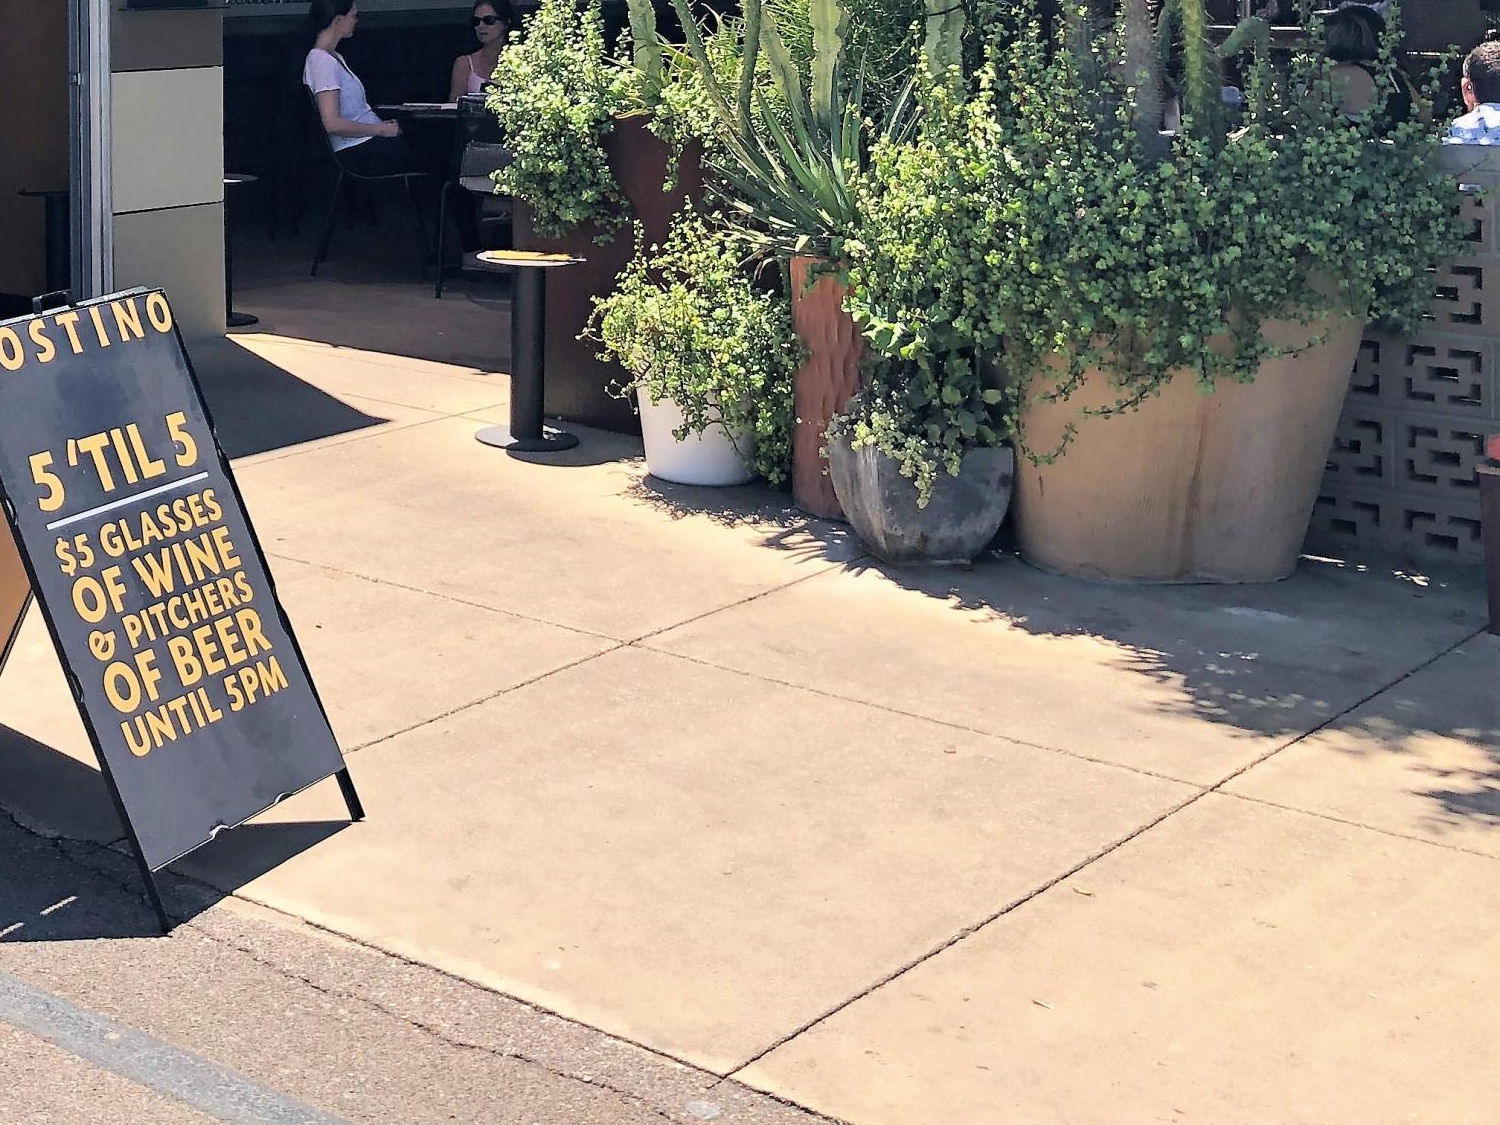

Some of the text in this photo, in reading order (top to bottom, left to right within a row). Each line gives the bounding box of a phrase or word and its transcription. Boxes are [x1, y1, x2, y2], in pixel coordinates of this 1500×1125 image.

[28, 411, 198, 512] 5 'TIL 5
[54, 489, 223, 577] $5 GLASSES
[71, 525, 242, 623] OF WINE
[88, 570, 254, 661] & PITCHERS
[103, 607, 273, 713] OF BEER
[120, 655, 290, 758] UNTIL 5PM
